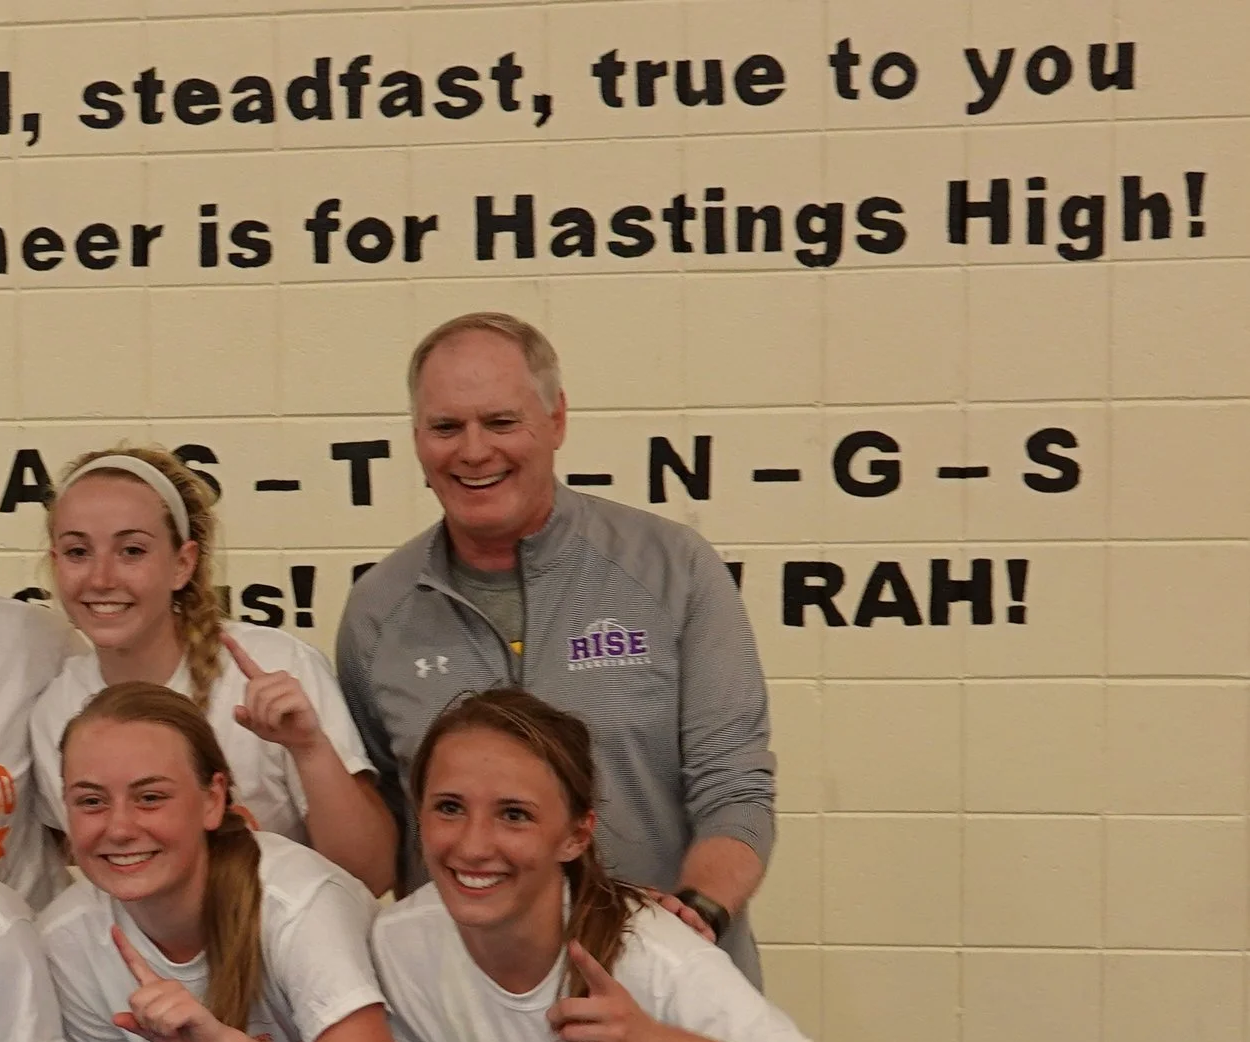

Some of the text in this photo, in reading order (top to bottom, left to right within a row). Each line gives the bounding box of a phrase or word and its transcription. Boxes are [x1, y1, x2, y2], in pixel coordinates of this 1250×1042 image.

[78, 52, 552, 130] steadfast,
[591, 49, 786, 108] true
[829, 38, 918, 100] to
[964, 41, 1136, 116] you
[199, 203, 272, 269] is
[305, 198, 438, 264] for
[475, 187, 908, 268] Hastings
[947, 171, 1206, 262] High!
[782, 558, 1030, 628] RAH!
[568, 630, 647, 662] RISE
